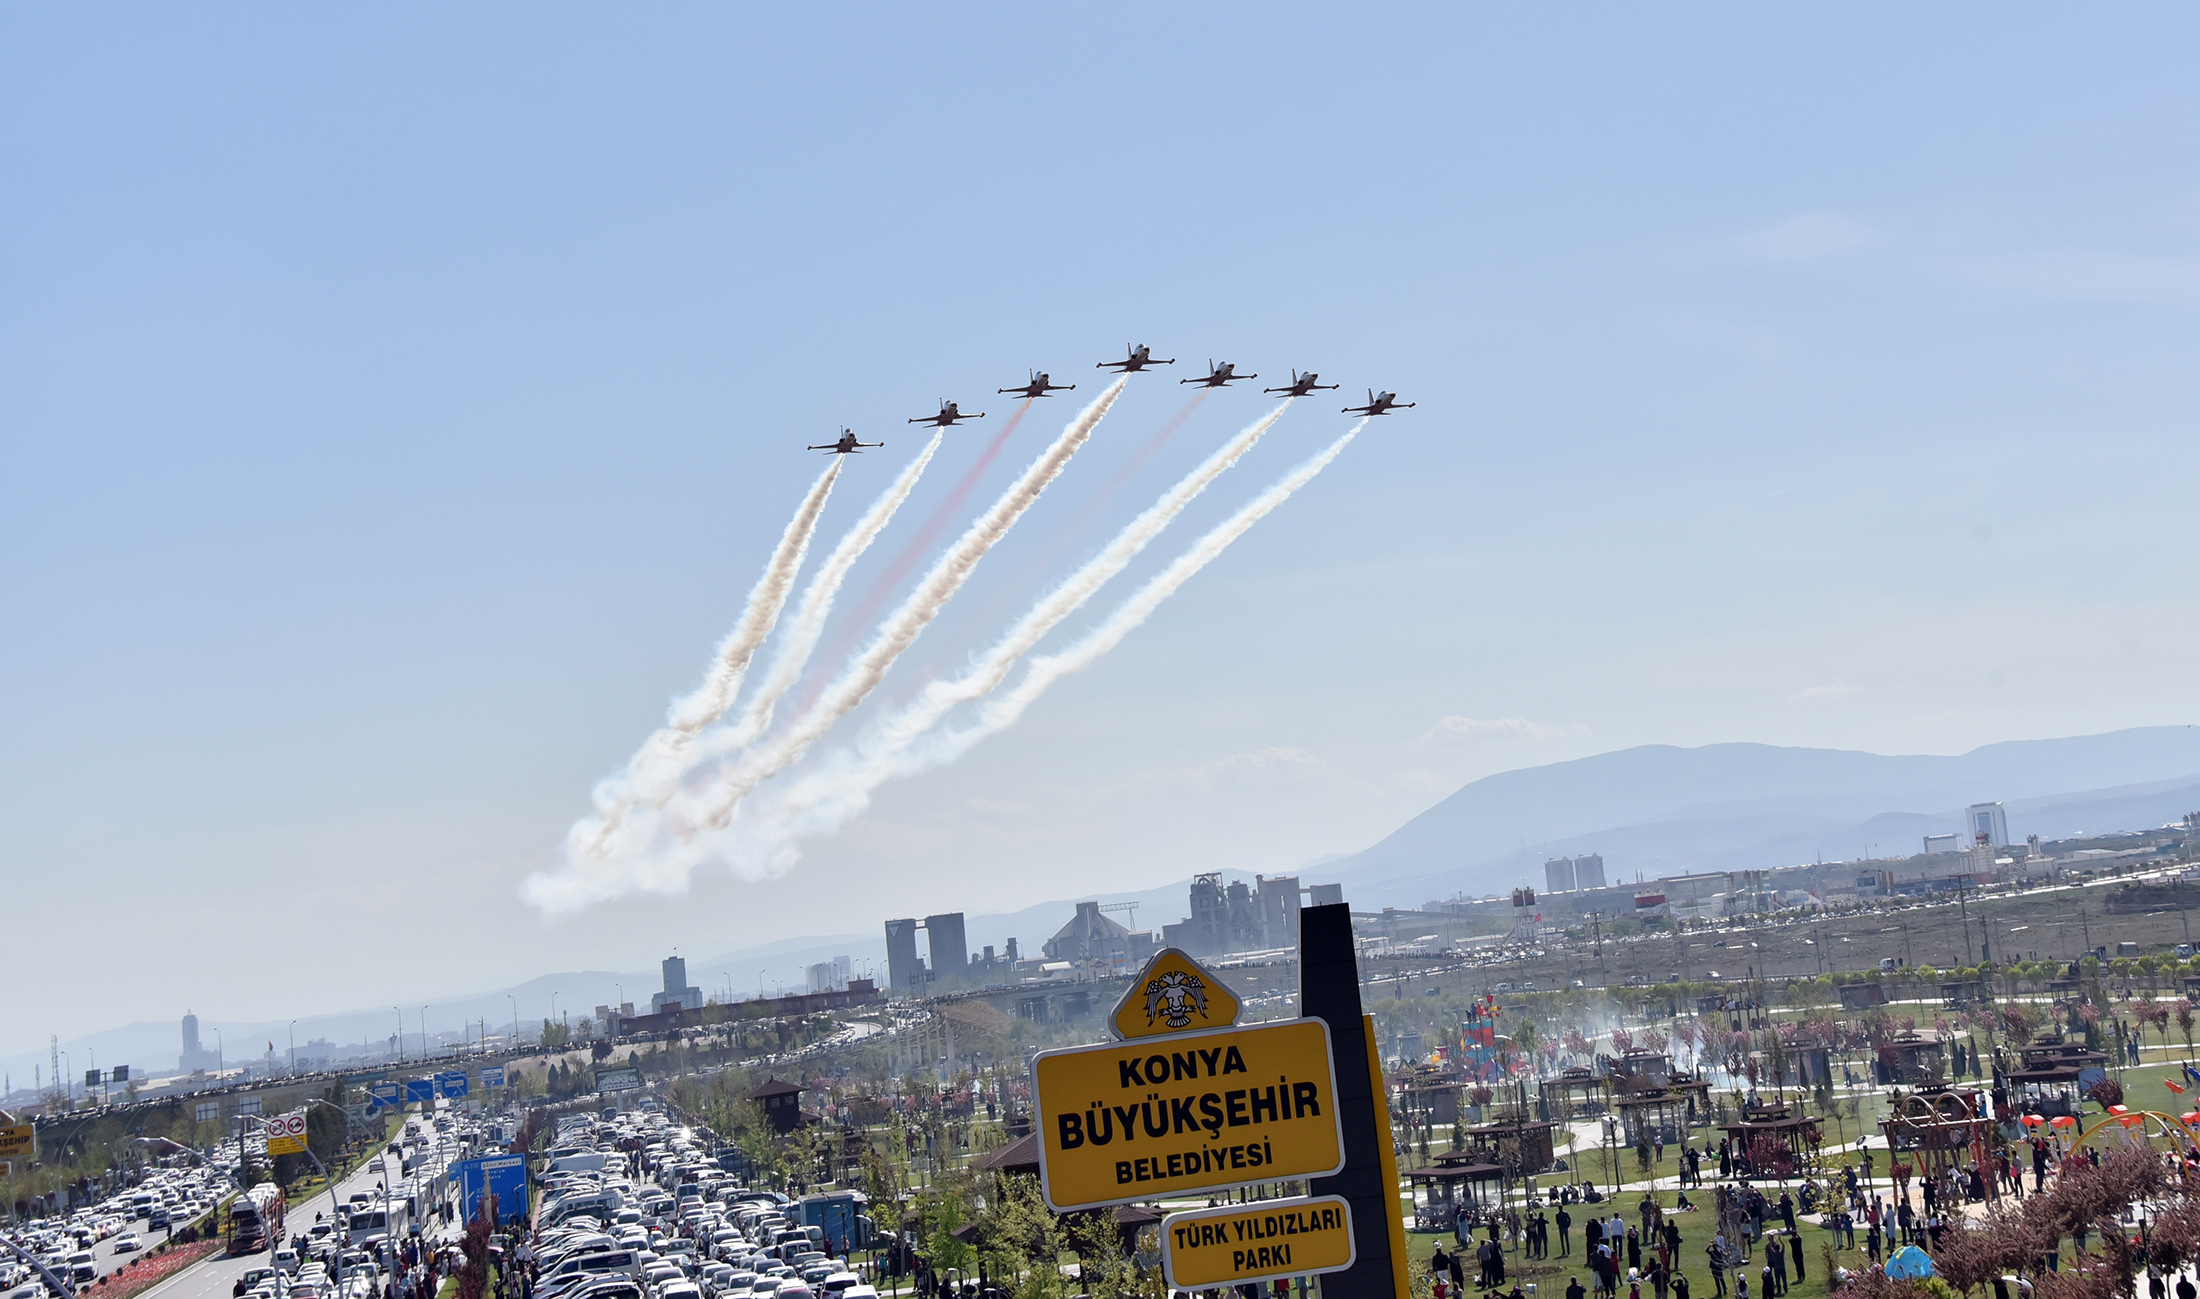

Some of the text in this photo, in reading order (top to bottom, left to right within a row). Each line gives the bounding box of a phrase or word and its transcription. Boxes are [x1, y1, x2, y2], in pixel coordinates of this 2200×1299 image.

[1118, 1045, 1248, 1089] KONYA
[1057, 1075, 1321, 1151] BÜYÜKŞEHİR
[1115, 1136, 1273, 1185] BELEDİYESİ
[1173, 1208, 1342, 1250] TÜRK YILDIZLARI
[1232, 1243, 1292, 1272] PARKI
